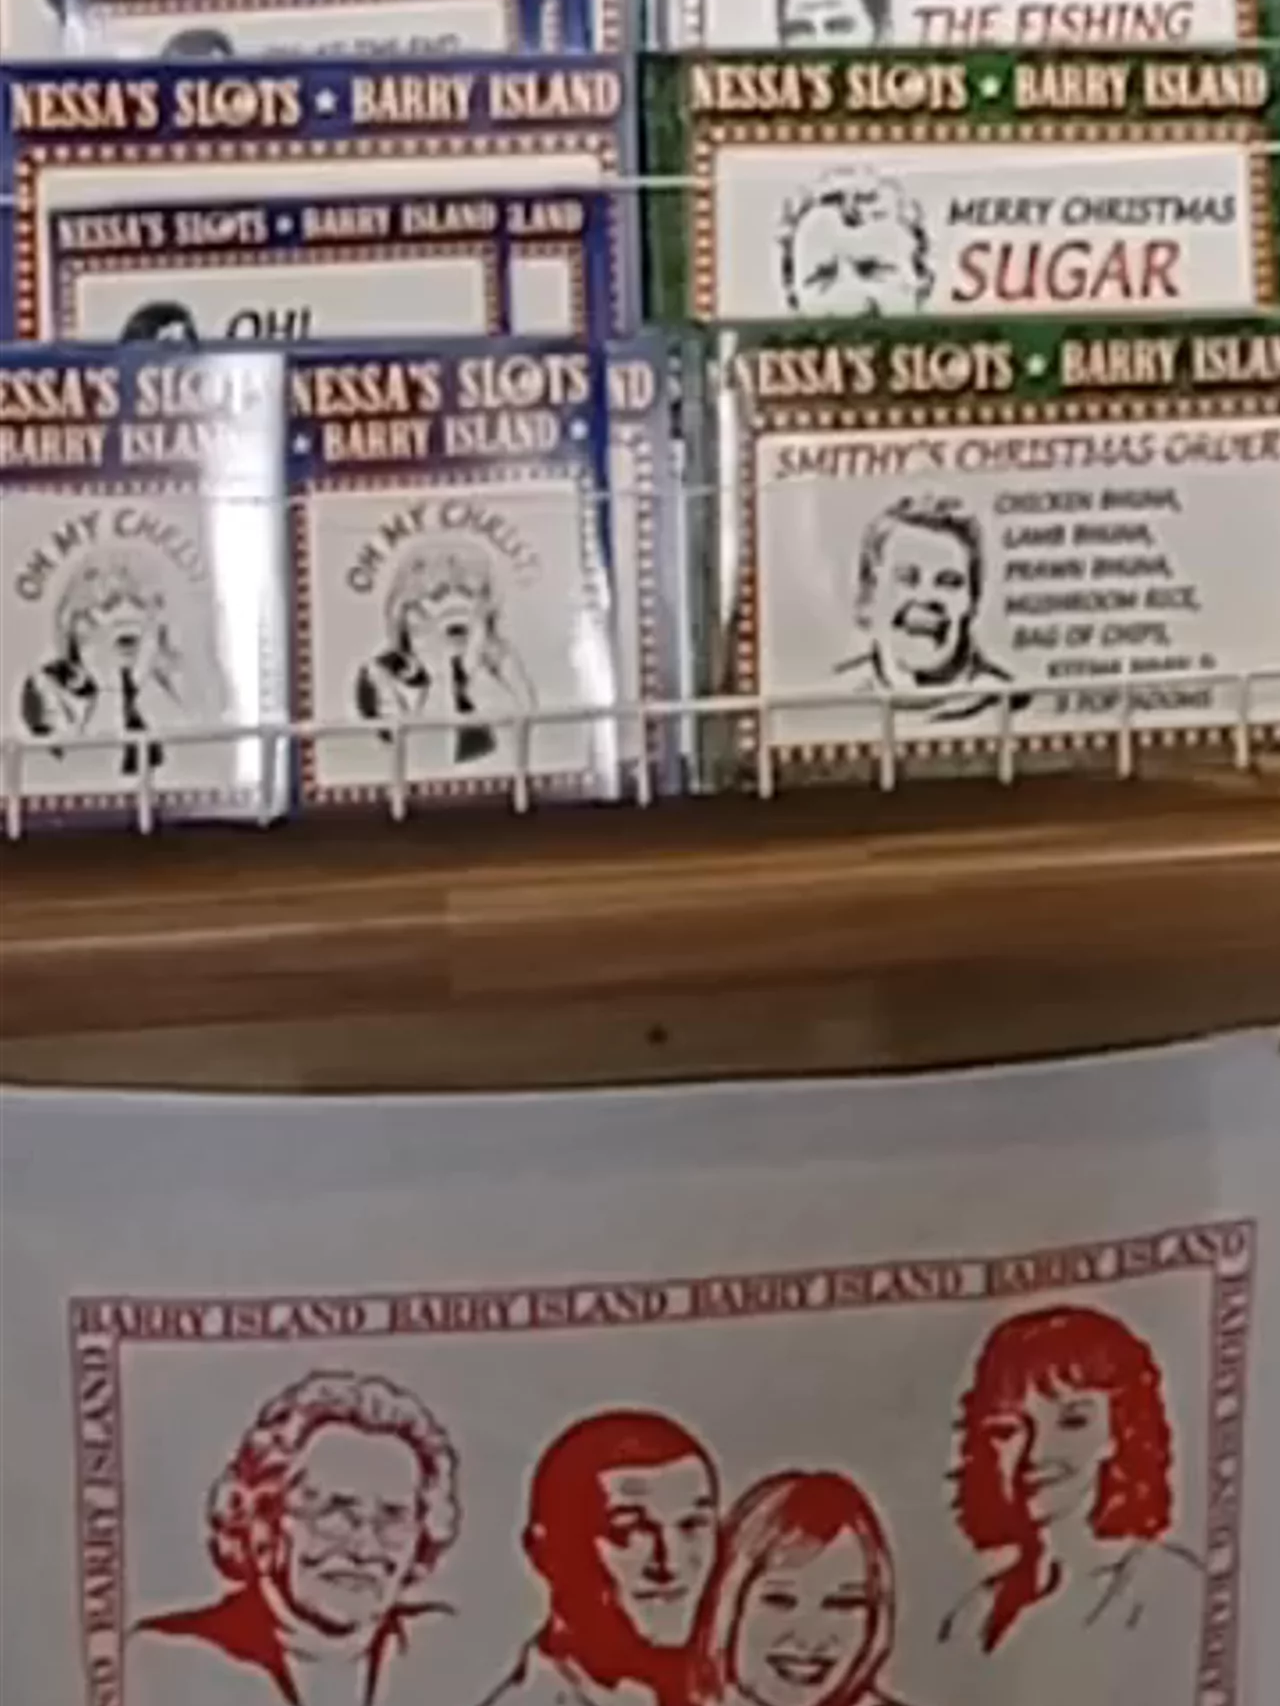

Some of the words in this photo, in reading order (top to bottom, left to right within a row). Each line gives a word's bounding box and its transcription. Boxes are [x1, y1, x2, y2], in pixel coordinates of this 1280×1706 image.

[351, 75, 476, 124] BARRY
[489, 73, 621, 120] ISLAND
[1015, 66, 1132, 109] BARRY
[1145, 64, 1269, 107] ISLAND
[946, 195, 1052, 228] MERRY
[1060, 195, 1239, 227] CHRISTMAS
[950, 239, 1182, 302] SUGAR
[1062, 338, 1178, 384] BARRY
[325, 418, 433, 461] BARRY
[444, 414, 560, 458] ISLAND
